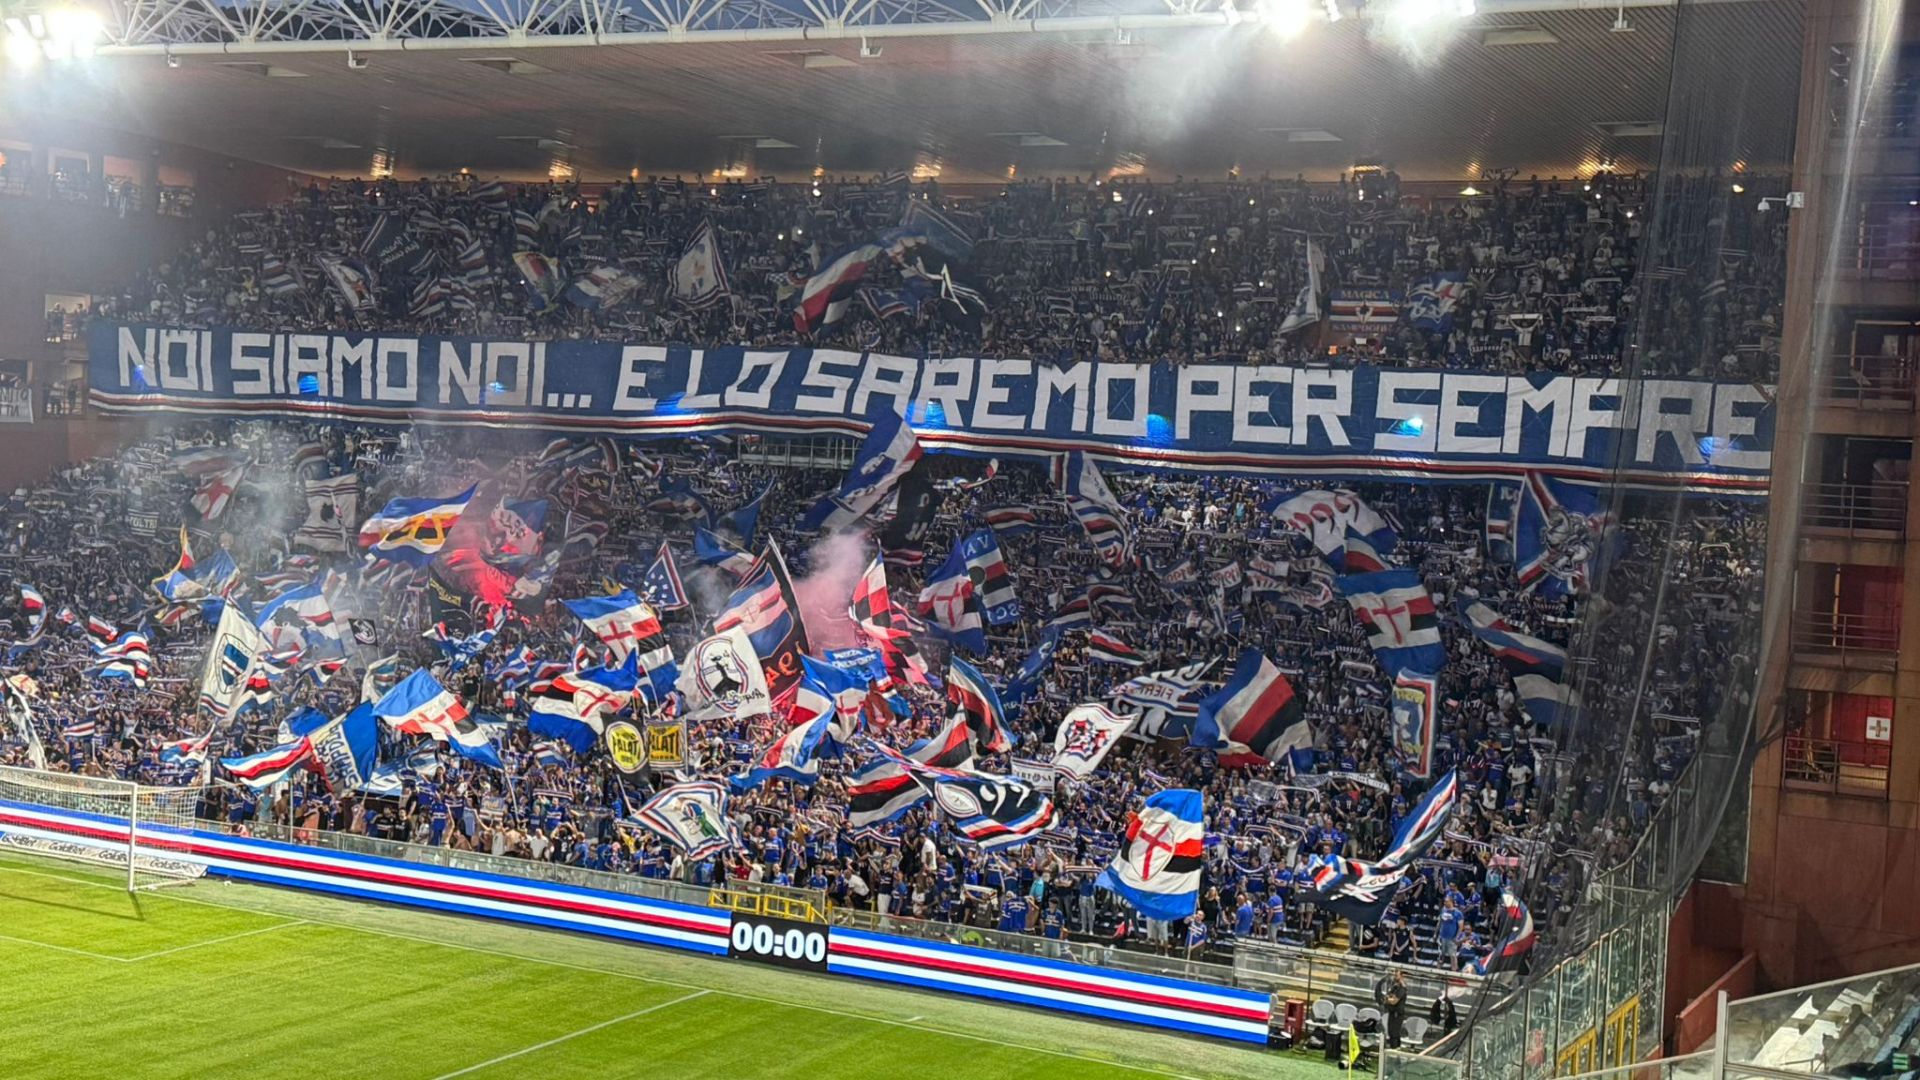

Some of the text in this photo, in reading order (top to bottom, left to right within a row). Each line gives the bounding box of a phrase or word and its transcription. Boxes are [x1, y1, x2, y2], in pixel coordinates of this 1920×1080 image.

[118, 326, 214, 391] NOI
[230, 333, 418, 401] SIAMO
[438, 341, 592, 408] NOI...
[612, 346, 668, 411] E
[677, 350, 790, 409] LO
[795, 349, 1151, 436] SAREMO
[1175, 365, 1353, 447] PER
[732, 922, 826, 962] 00:00
